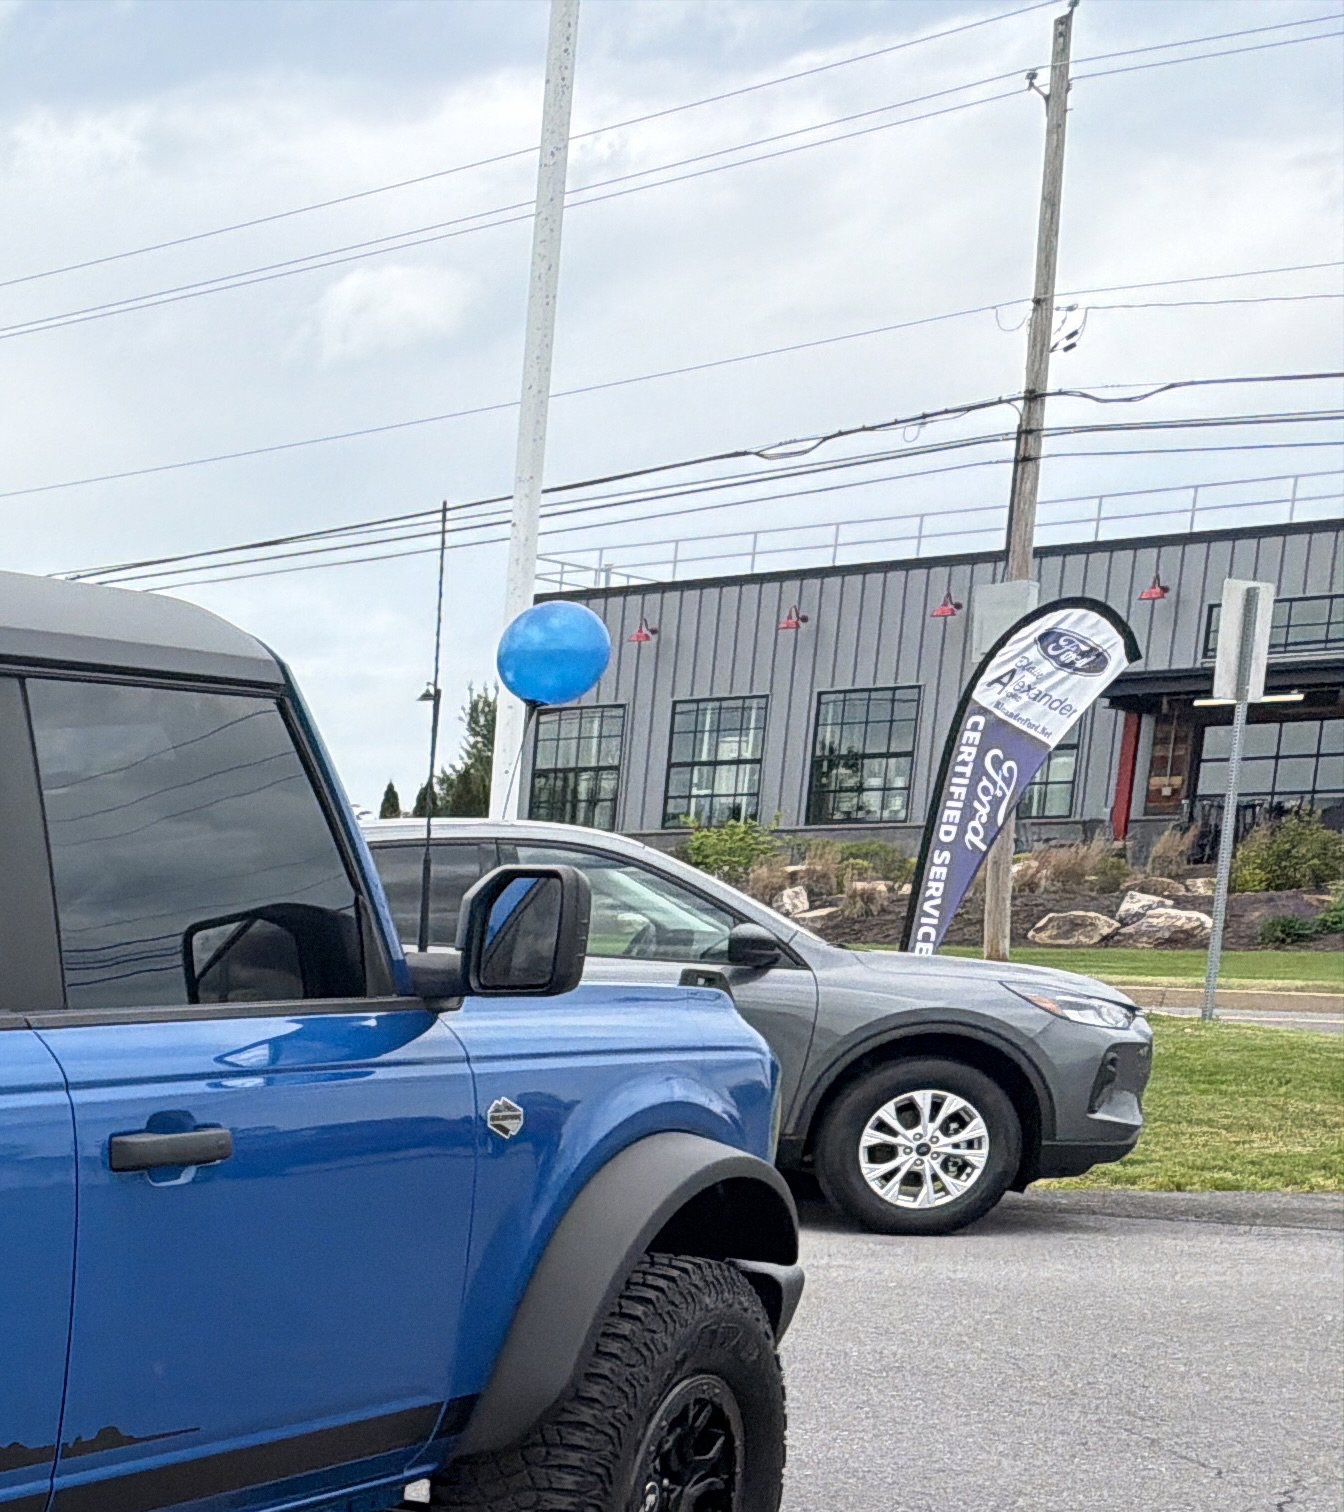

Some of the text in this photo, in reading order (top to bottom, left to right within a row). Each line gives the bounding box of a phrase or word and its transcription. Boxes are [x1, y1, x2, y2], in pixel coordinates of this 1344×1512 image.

[1047, 635, 1100, 669] Ford
[986, 668, 1079, 719] Alexander
[938, 715, 986, 843] CERTIFIED
[964, 748, 1018, 852] Ford
